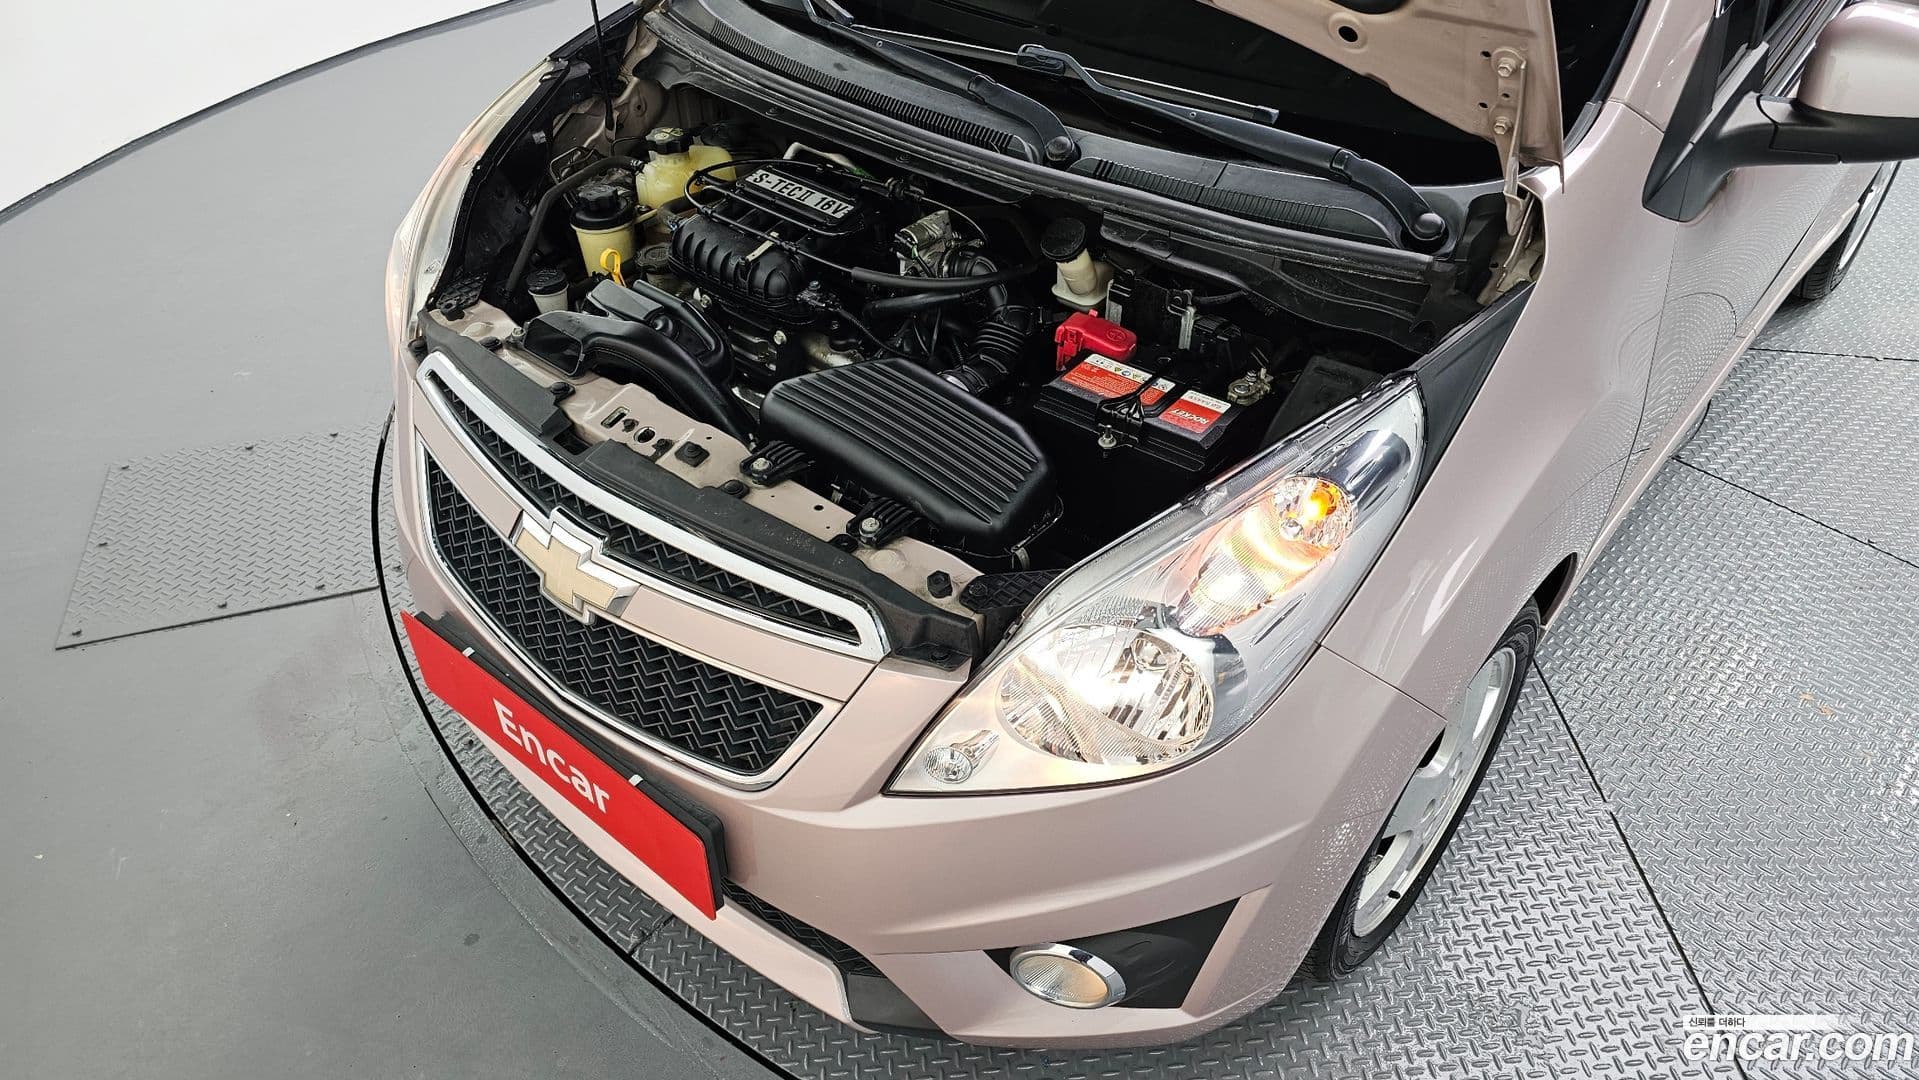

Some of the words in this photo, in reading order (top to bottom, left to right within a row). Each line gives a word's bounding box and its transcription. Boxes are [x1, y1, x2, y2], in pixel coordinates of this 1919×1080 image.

[814, 196, 849, 215] 16V
[1169, 408, 1209, 425] ROCKET
[493, 697, 610, 814] Encar
